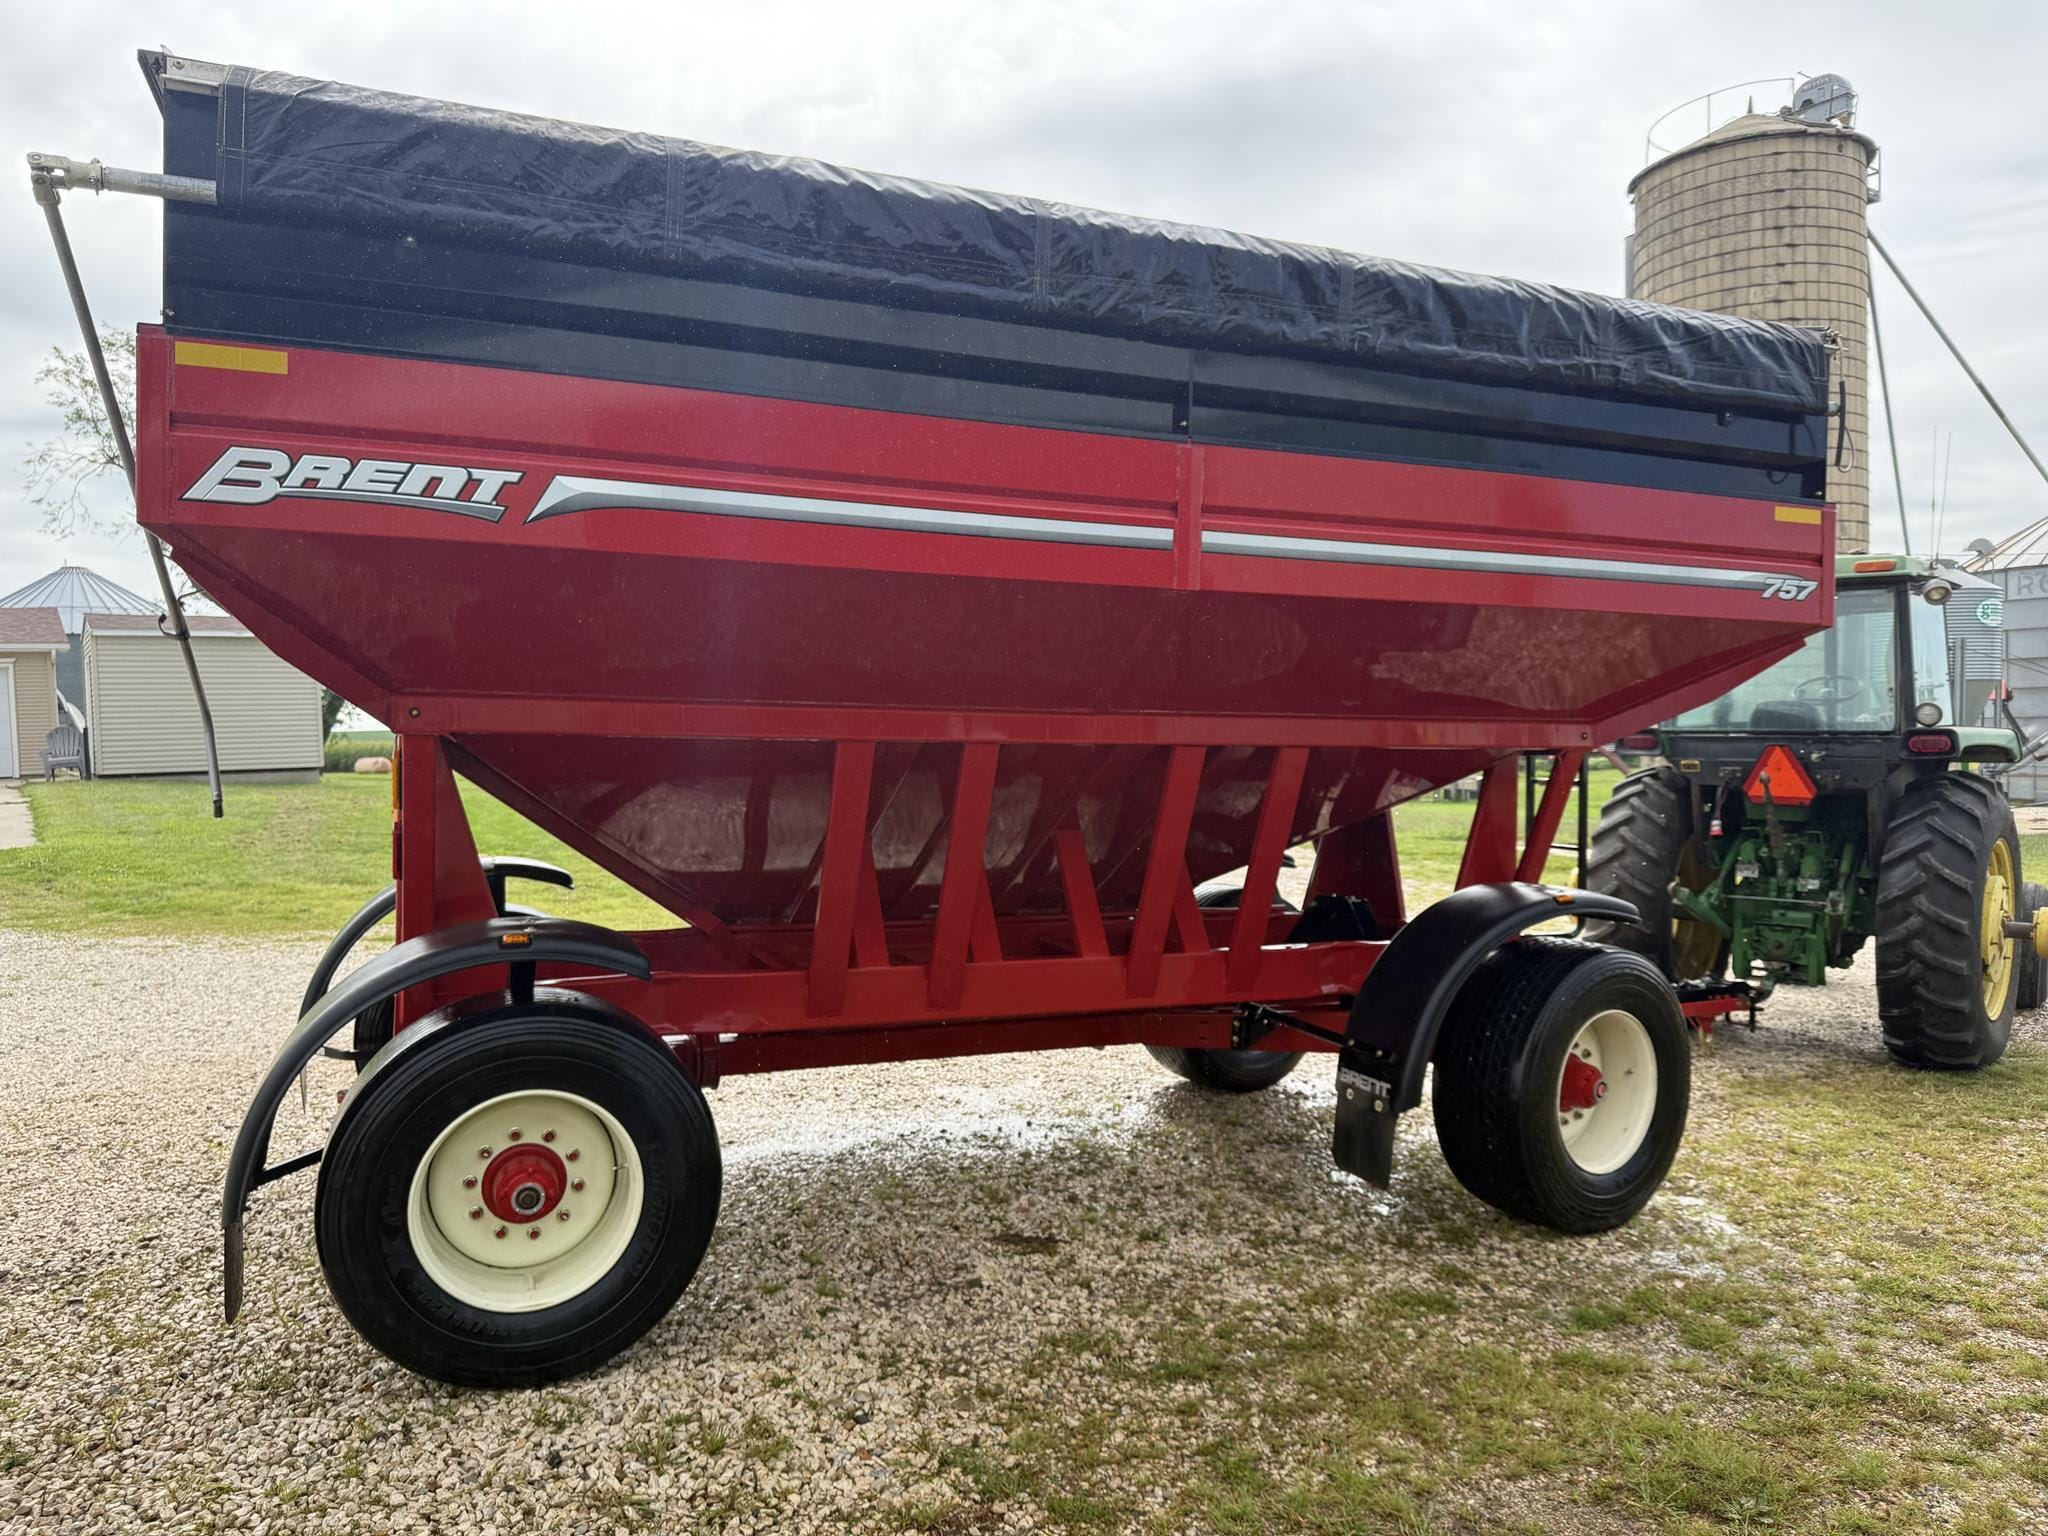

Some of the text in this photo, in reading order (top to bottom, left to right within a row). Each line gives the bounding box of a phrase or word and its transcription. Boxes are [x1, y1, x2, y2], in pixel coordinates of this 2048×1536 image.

[182, 446, 526, 507] BRENT
[1761, 578, 1818, 601] 757
[1340, 1067, 1392, 1098] BRENT
